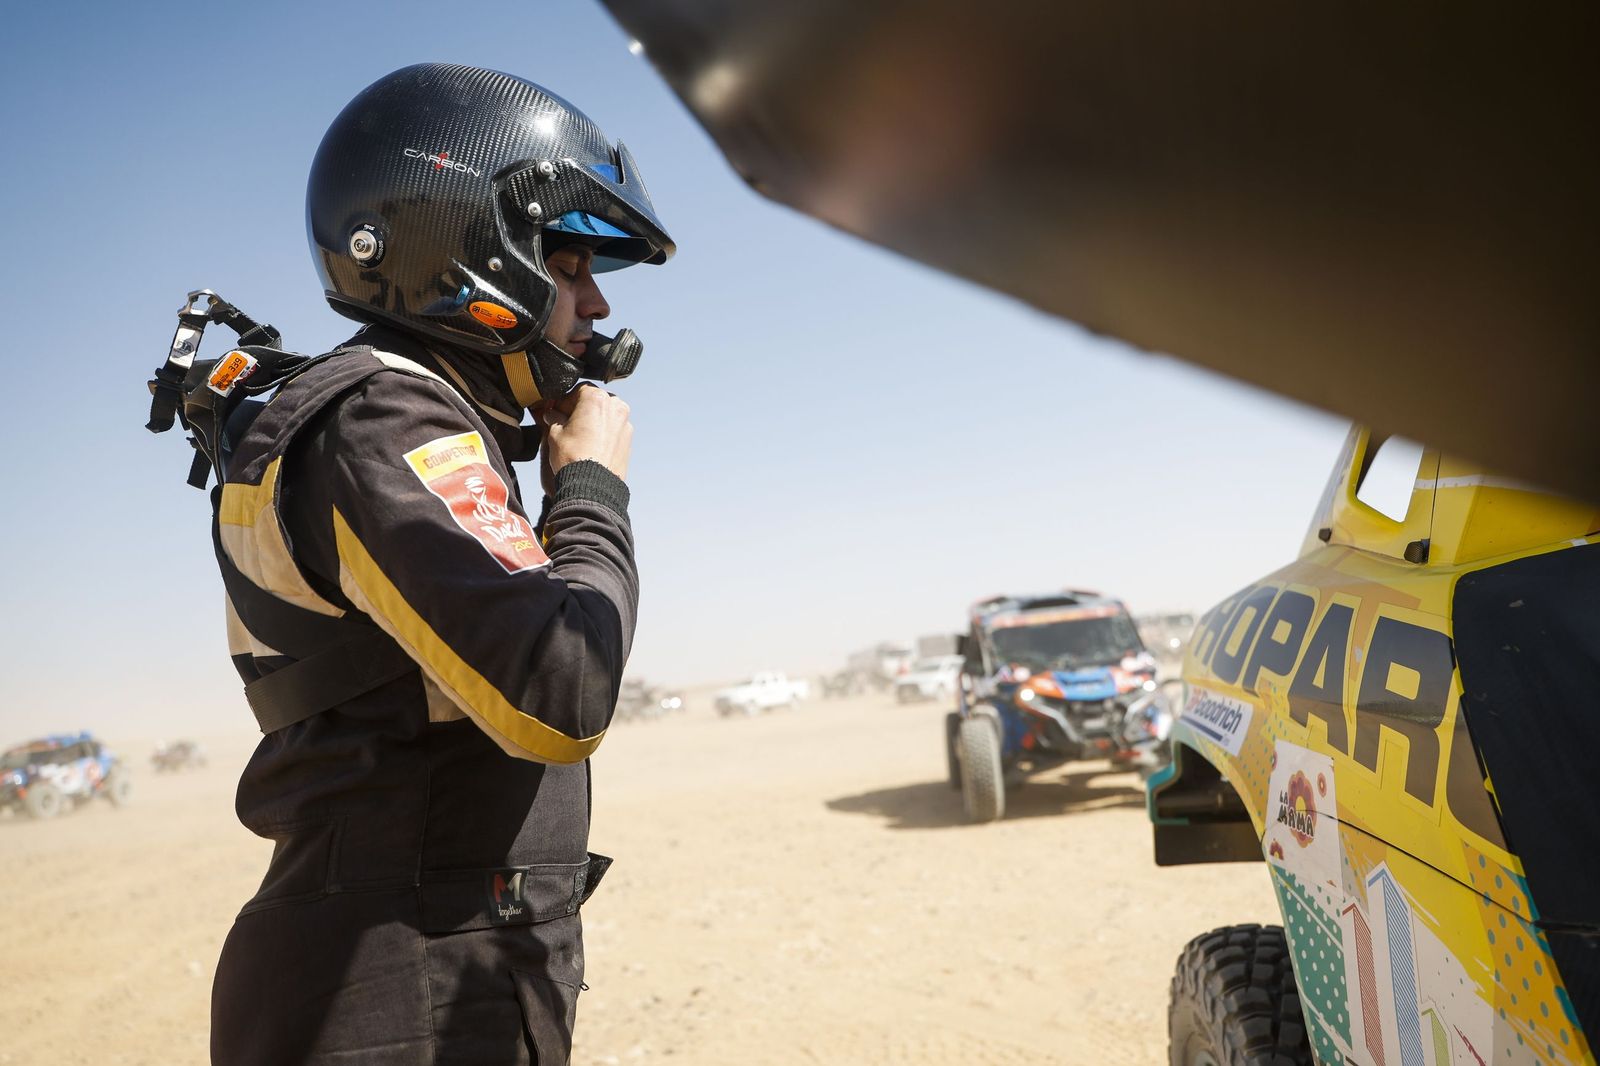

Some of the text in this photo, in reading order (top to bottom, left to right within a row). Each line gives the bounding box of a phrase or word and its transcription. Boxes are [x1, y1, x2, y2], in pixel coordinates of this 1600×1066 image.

[404, 148, 480, 177] CARBON
[228, 357, 242, 373] 339
[1279, 789, 1289, 803] LA
[1277, 805, 1315, 837] MAMA
